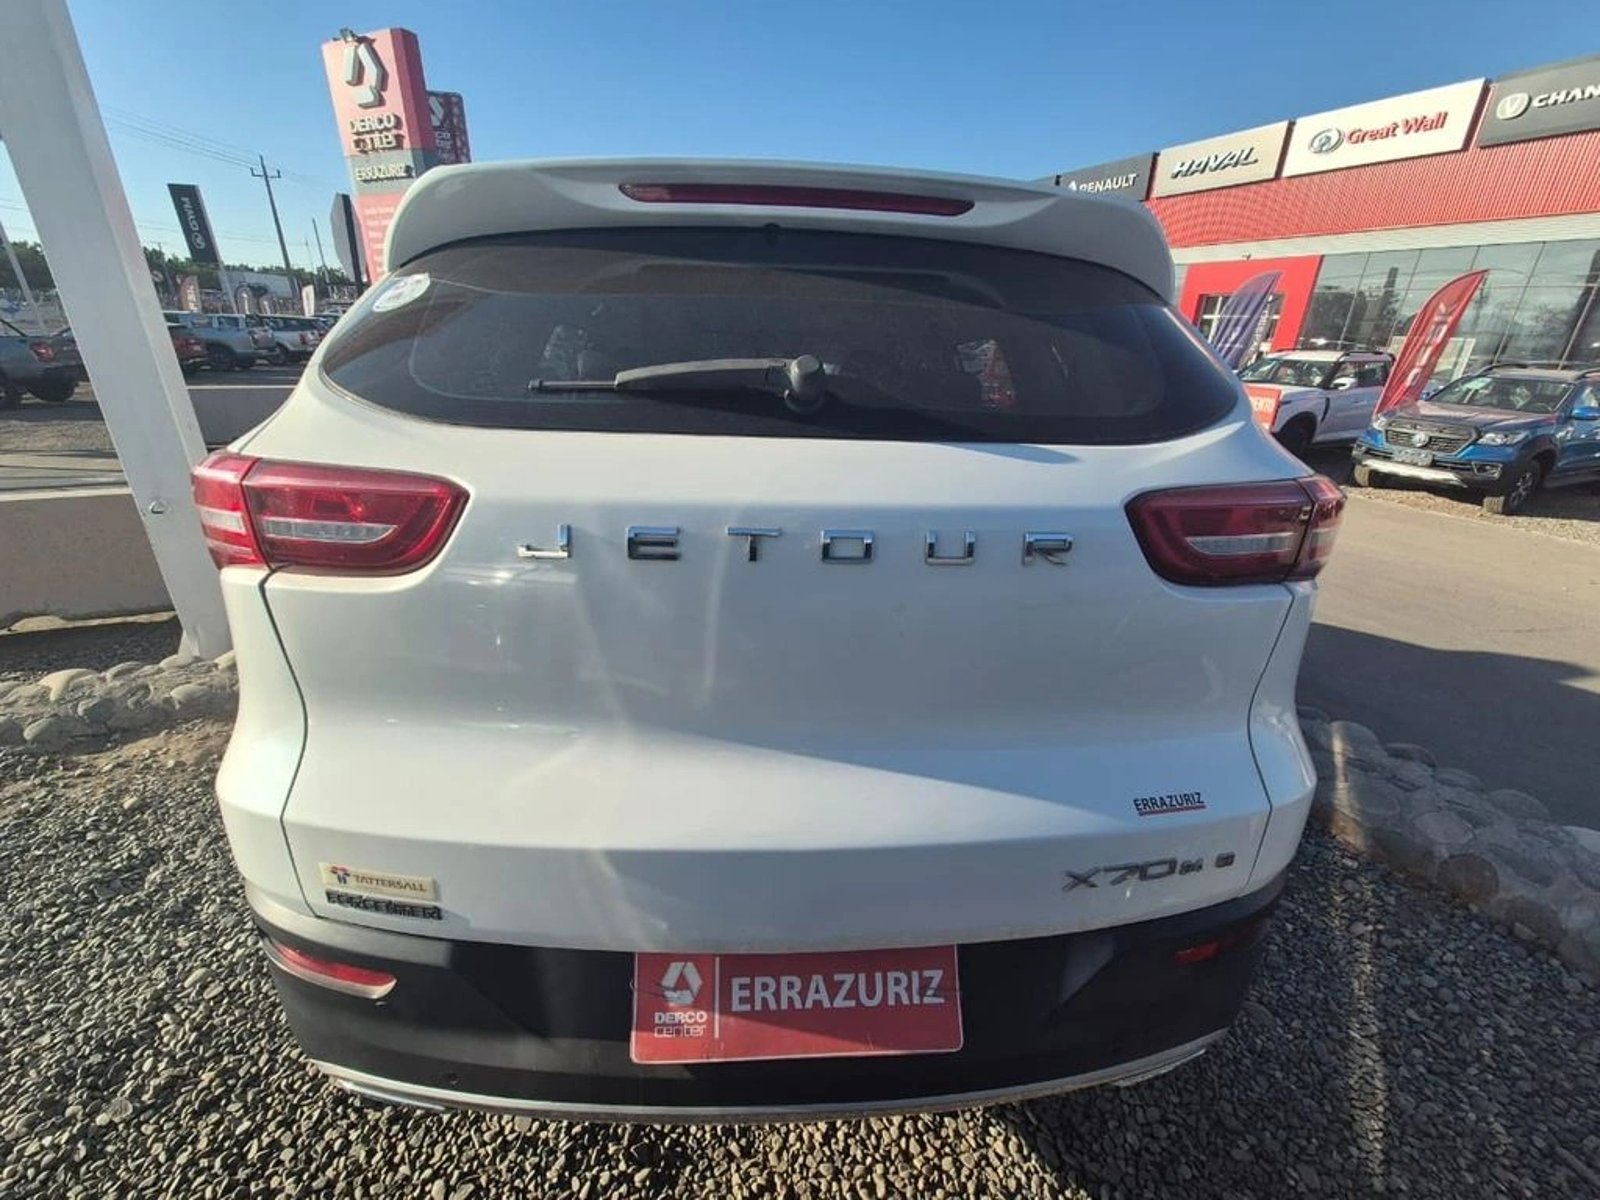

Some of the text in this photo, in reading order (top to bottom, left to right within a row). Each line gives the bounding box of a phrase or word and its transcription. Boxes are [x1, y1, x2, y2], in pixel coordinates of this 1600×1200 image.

[1347, 111, 1447, 144] Great Wall
[1171, 148, 1258, 179] HAVAL
[514, 523, 1075, 566] JETOUR
[1133, 792, 1204, 812] ERRAZURIZ
[352, 874, 427, 893] TATTERSALL
[1062, 858, 1177, 891] X70
[732, 969, 945, 1012] ERRAZURIZ
[654, 1010, 708, 1024] DERCO
